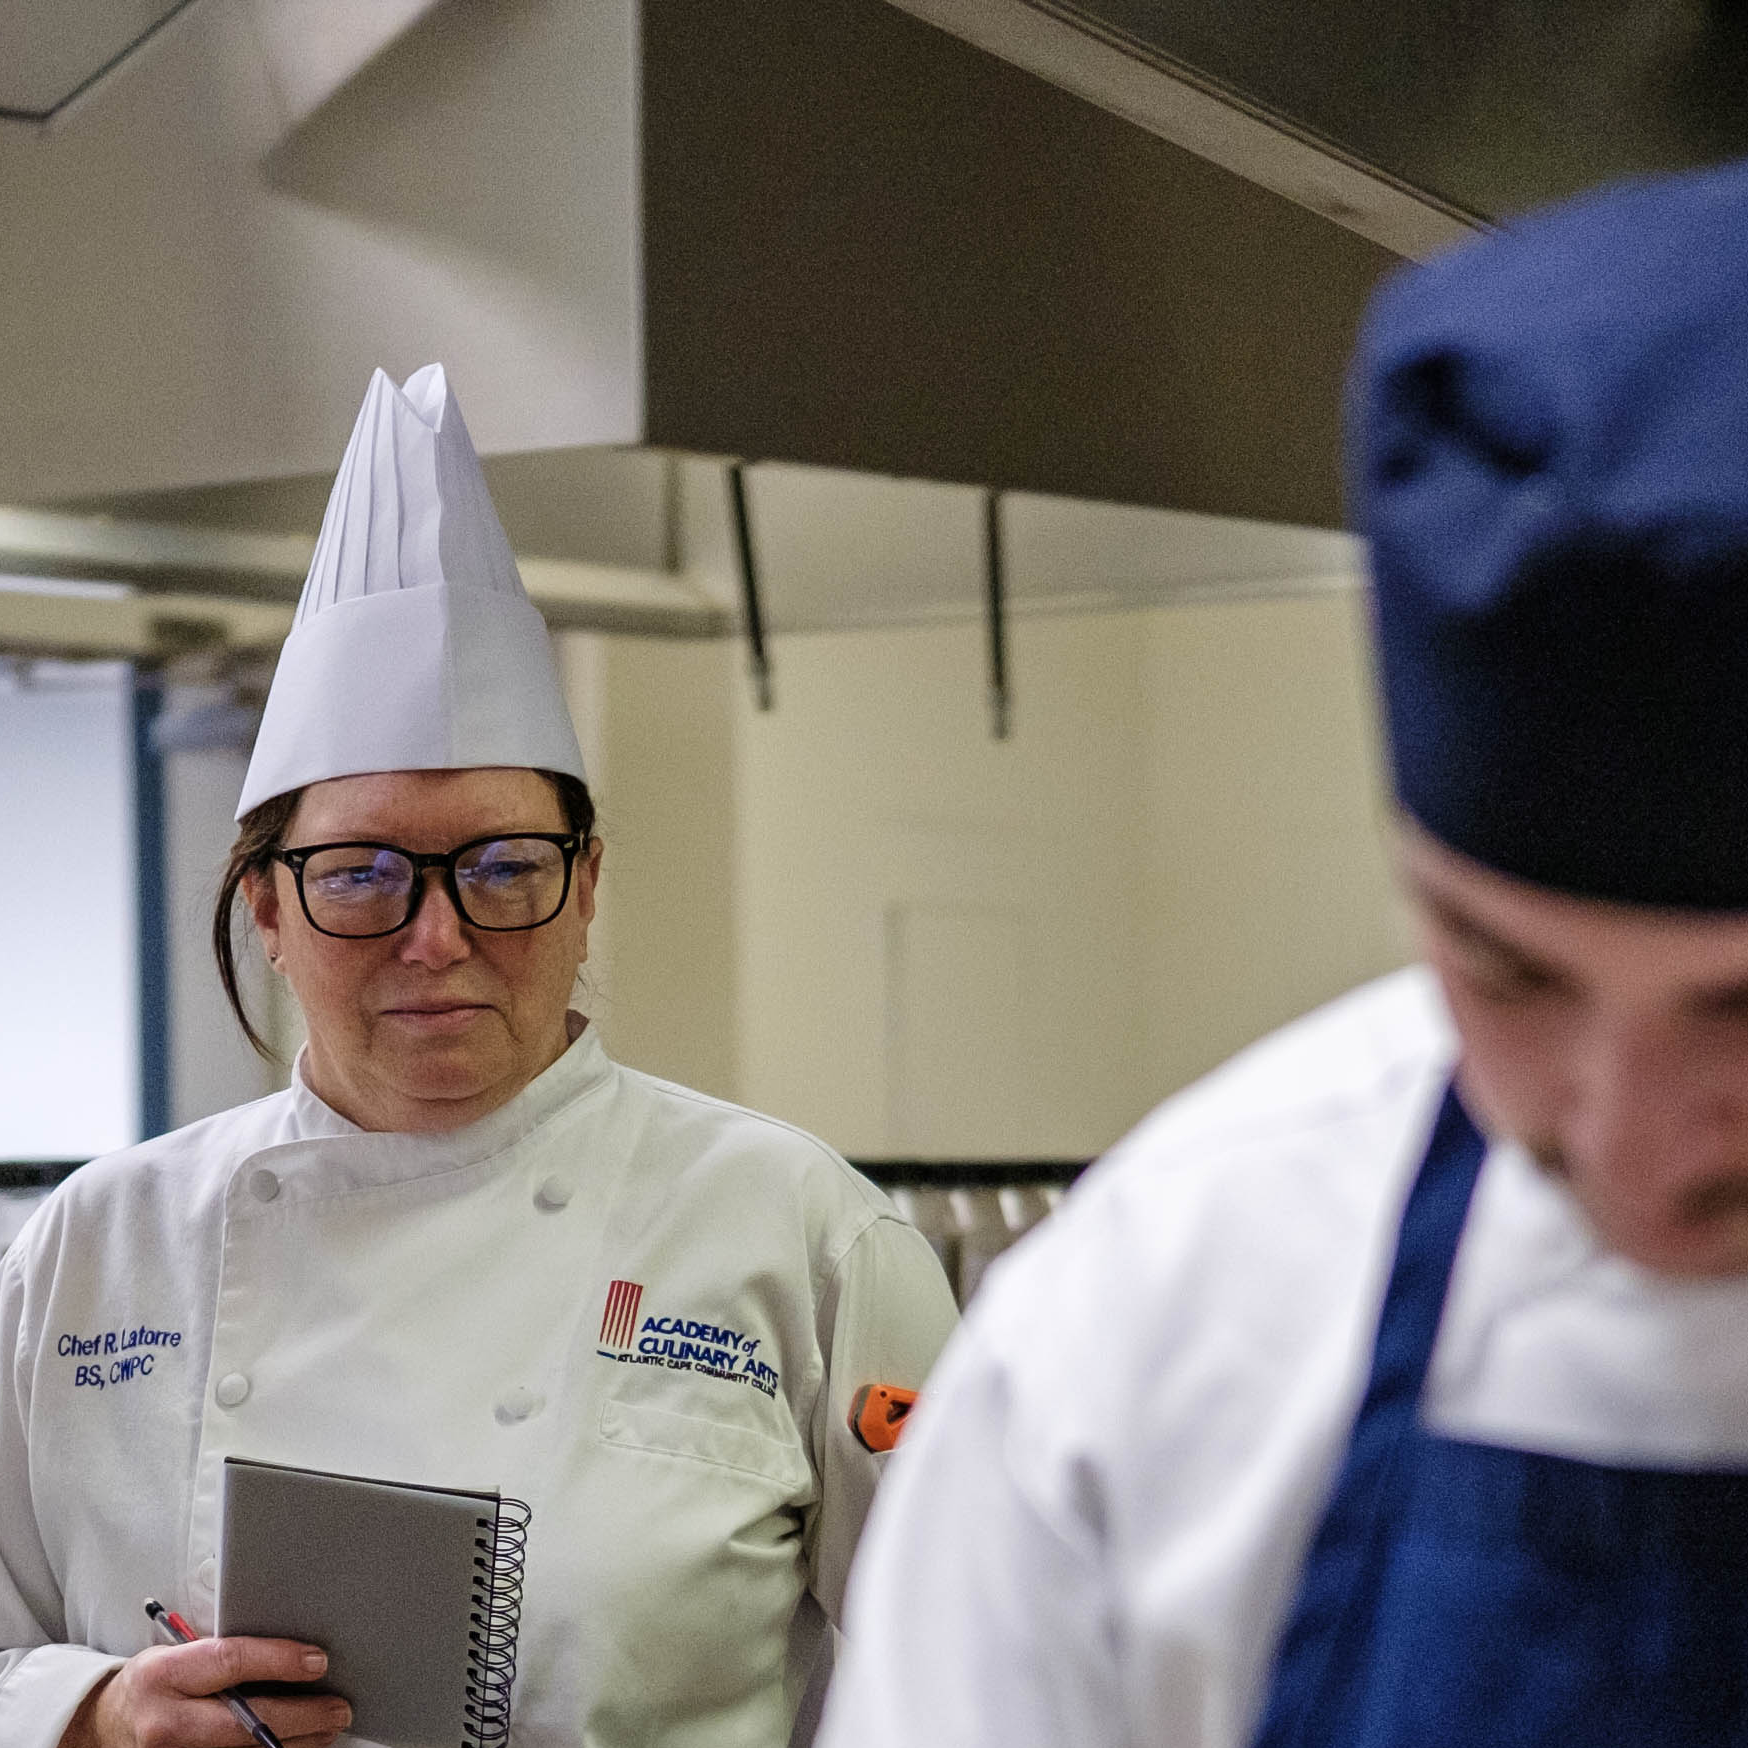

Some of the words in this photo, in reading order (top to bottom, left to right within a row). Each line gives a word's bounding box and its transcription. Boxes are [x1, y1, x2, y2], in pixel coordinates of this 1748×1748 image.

[58, 1334, 101, 1356] Chef
[104, 1333, 118, 1354] R.
[121, 1325, 181, 1350] Latorre
[641, 1317, 744, 1351] ACADEMY
[742, 1338, 761, 1357] of
[74, 1365, 105, 1391] BS,
[109, 1354, 155, 1384] CWPC
[617, 1353, 665, 1367] ATLANTIC
[666, 1358, 692, 1371] CAPE
[694, 1363, 750, 1385] COMMUNITY
[638, 1336, 739, 1371] CULINARY
[742, 1357, 779, 1389] ARTS
